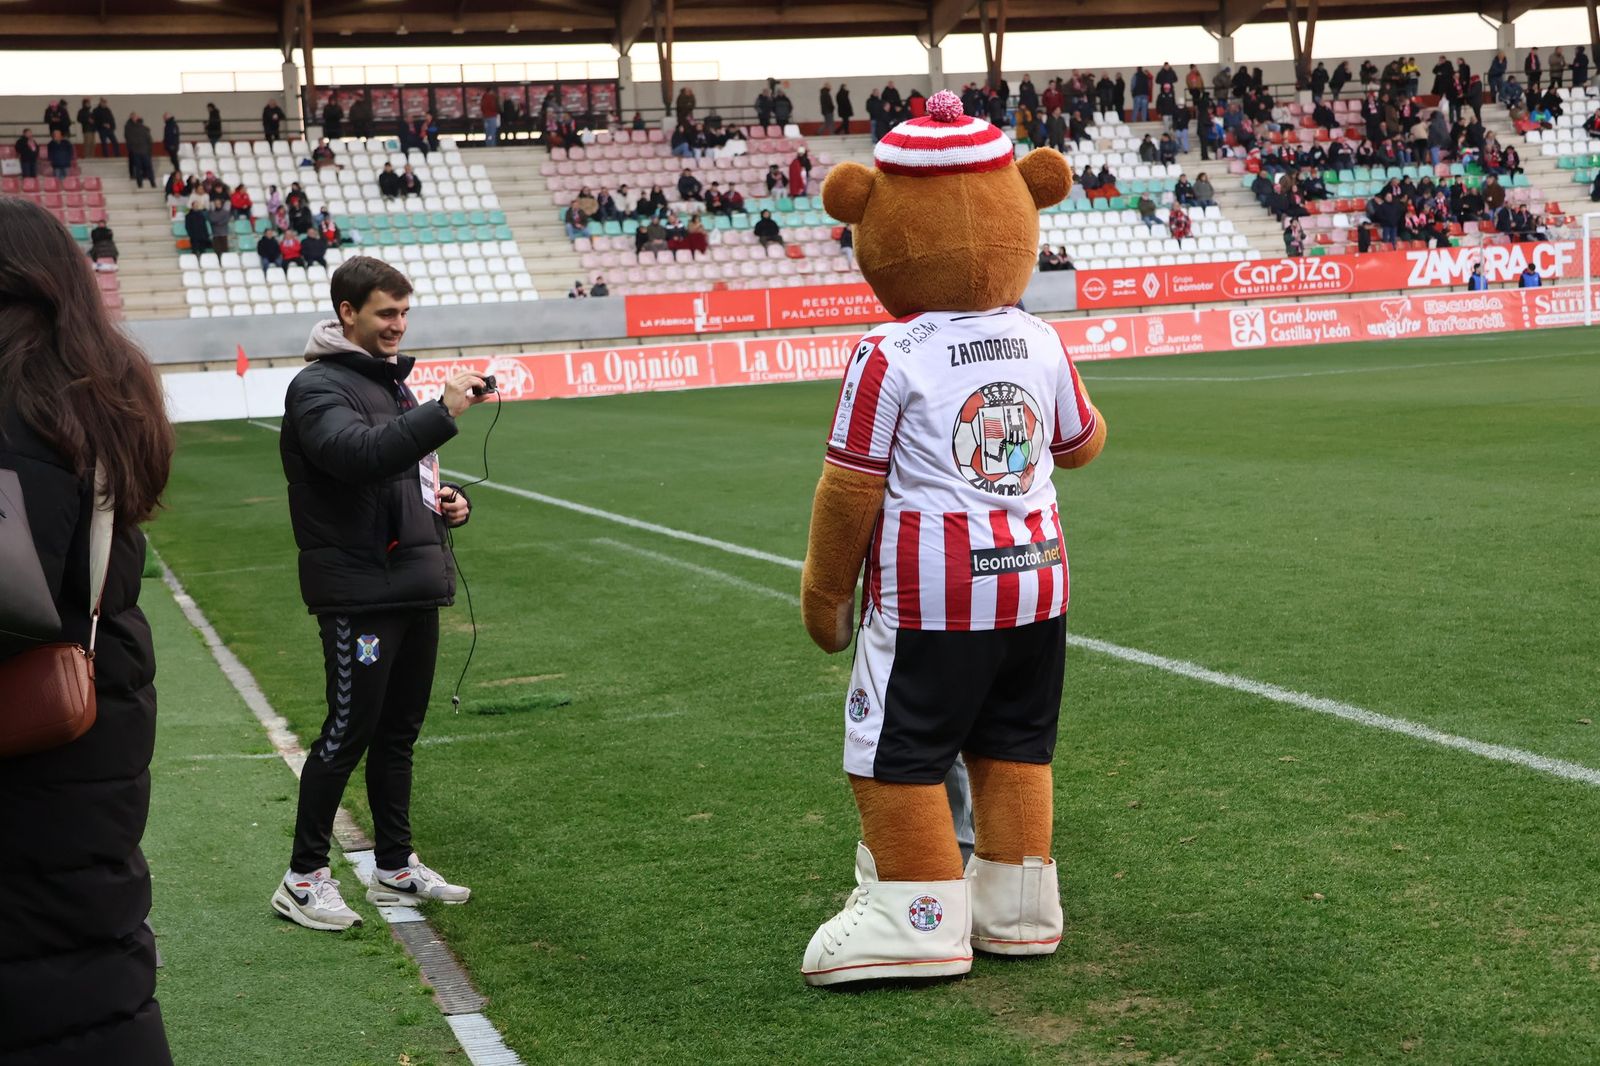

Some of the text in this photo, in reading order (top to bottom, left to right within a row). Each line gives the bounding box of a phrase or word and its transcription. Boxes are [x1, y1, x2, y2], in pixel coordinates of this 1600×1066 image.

[1532, 242, 1576, 278] CF
[1173, 282, 1215, 292] Leomotor
[1233, 283, 1289, 294] EMBUTIDOS
[1298, 280, 1341, 291] JAMONES
[802, 295, 881, 308] RESTAURAN
[782, 308, 840, 320] PALACIO
[844, 305, 870, 317] DEL
[1269, 307, 1338, 325] Carné Joven
[640, 319, 653, 328] LA
[723, 315, 736, 323] LA
[1167, 333, 1203, 344] Junta de
[1271, 322, 1352, 343] Castilla y León
[947, 338, 1029, 367] ZAMOROSO
[1066, 341, 1111, 354] uventud
[1144, 343, 1175, 355] Castilla
[1182, 342, 1205, 352] León
[738, 339, 851, 380] La Opinió
[564, 349, 699, 391] La Opinión
[804, 368, 817, 378] de
[632, 379, 646, 389] de
[973, 545, 1061, 572] leomotor.net
